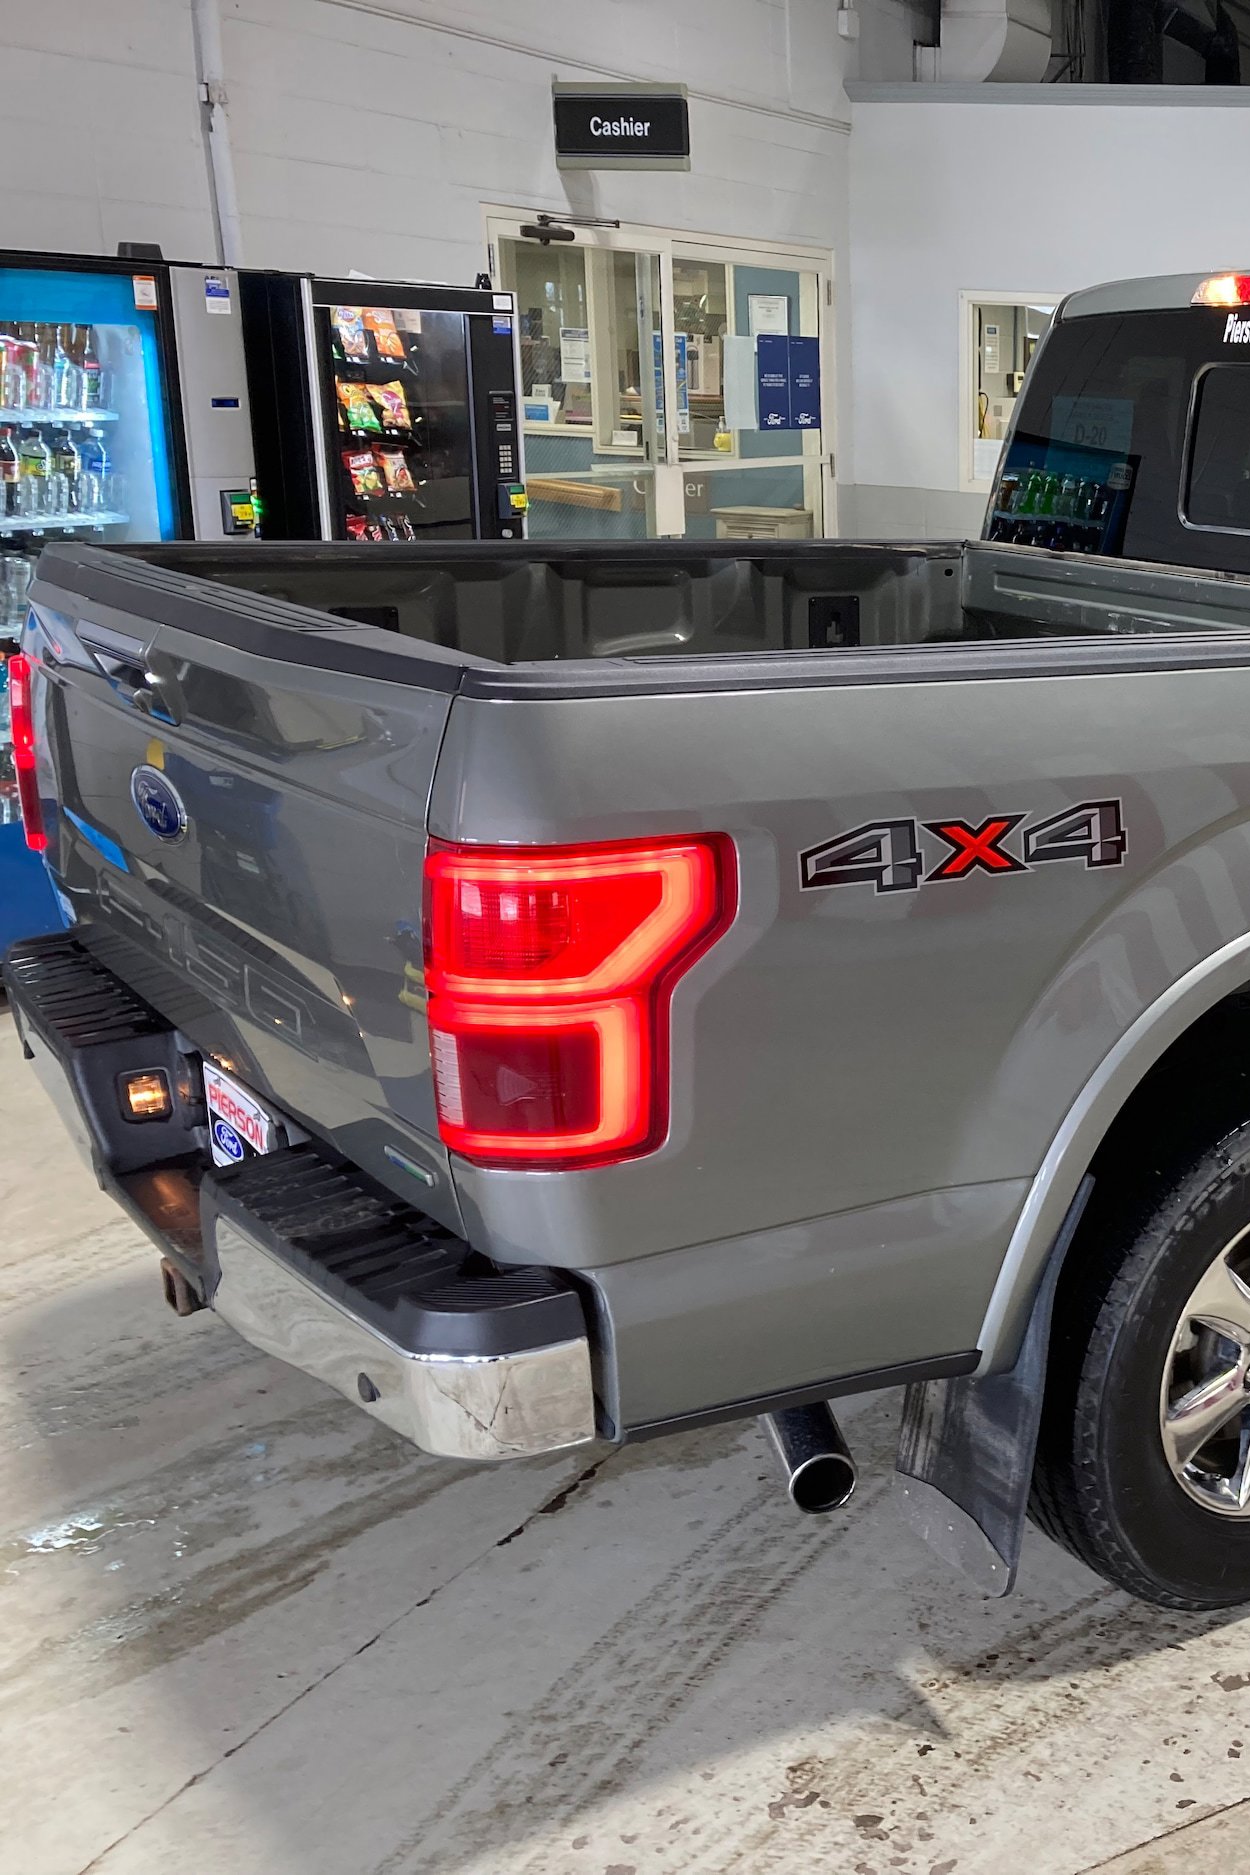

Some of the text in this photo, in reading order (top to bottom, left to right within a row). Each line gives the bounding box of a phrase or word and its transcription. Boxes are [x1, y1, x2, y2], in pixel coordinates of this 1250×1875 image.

[589, 116, 651, 136] Cashier
[208, 1084, 264, 1151] PIERSON
[220, 1126, 239, 1156] Ford
